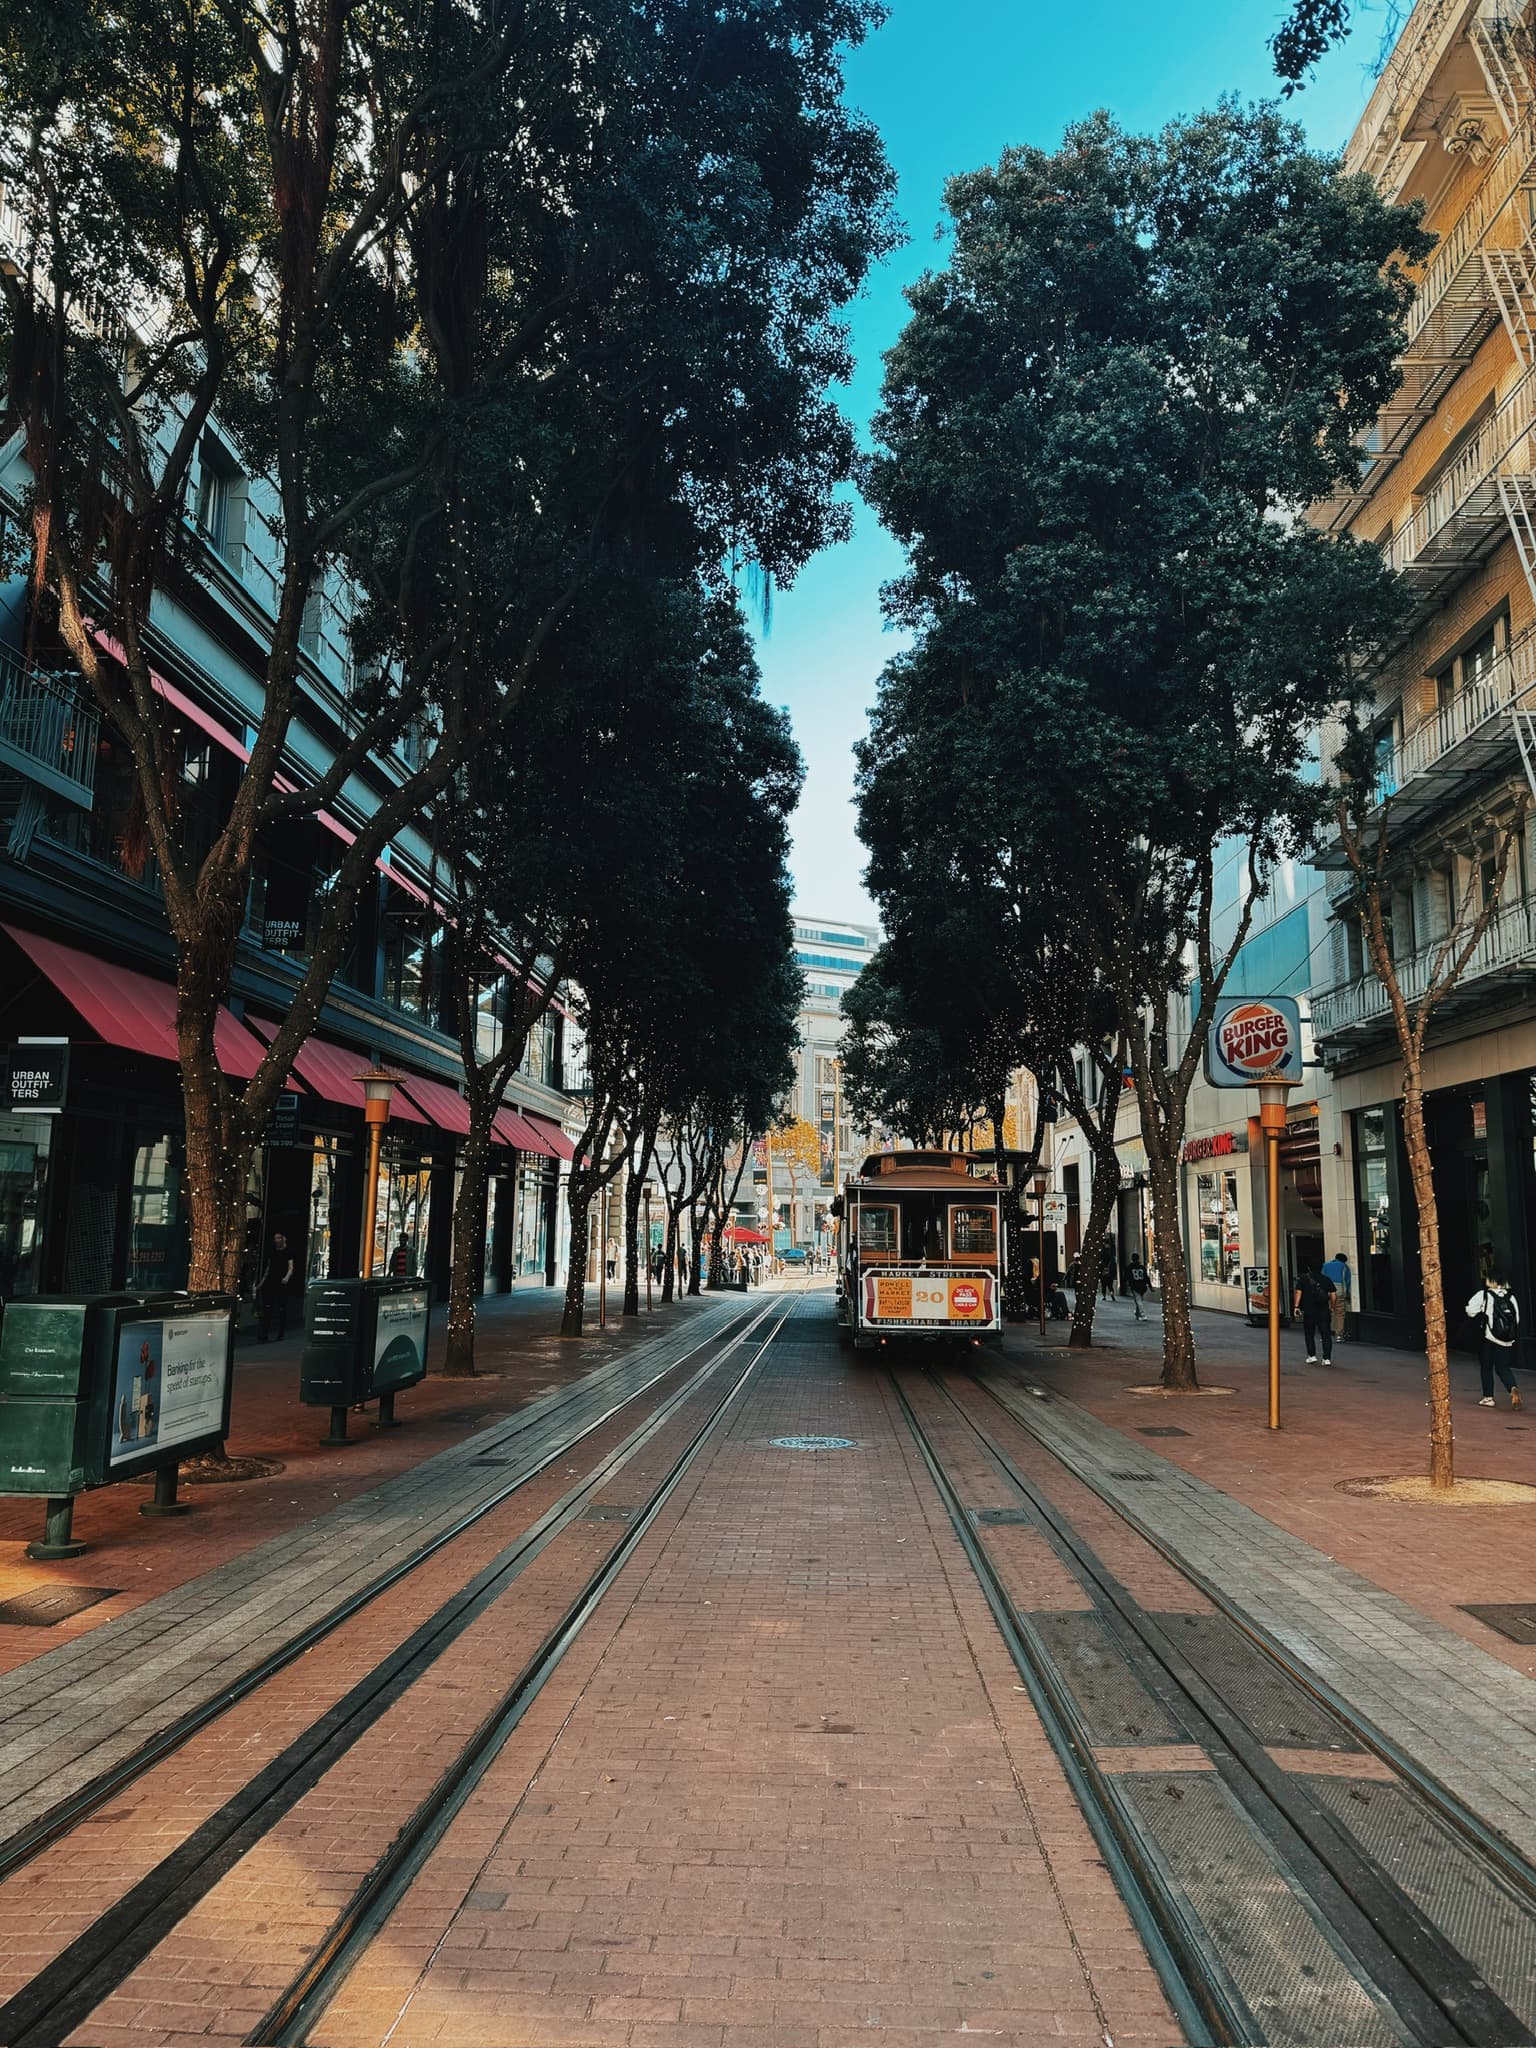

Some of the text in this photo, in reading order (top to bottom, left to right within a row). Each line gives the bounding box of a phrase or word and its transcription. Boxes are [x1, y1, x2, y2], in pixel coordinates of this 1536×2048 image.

[264, 920, 299, 929] URBAN
[264, 929, 303, 938] OUTFIT-
[264, 937, 288, 945] TERS
[1223, 1015, 1285, 1043] BURGER
[1226, 1028, 1288, 1064] KING
[12, 1071, 50, 1080] URBAN
[11, 1080, 54, 1089] OUTFIT-
[11, 1089, 40, 1098] TERS
[1212, 1131, 1233, 1157] KING
[1249, 1270, 1258, 1281] 2
[915, 1291, 944, 1304] 20
[167, 1359, 206, 1376] Banking for the
